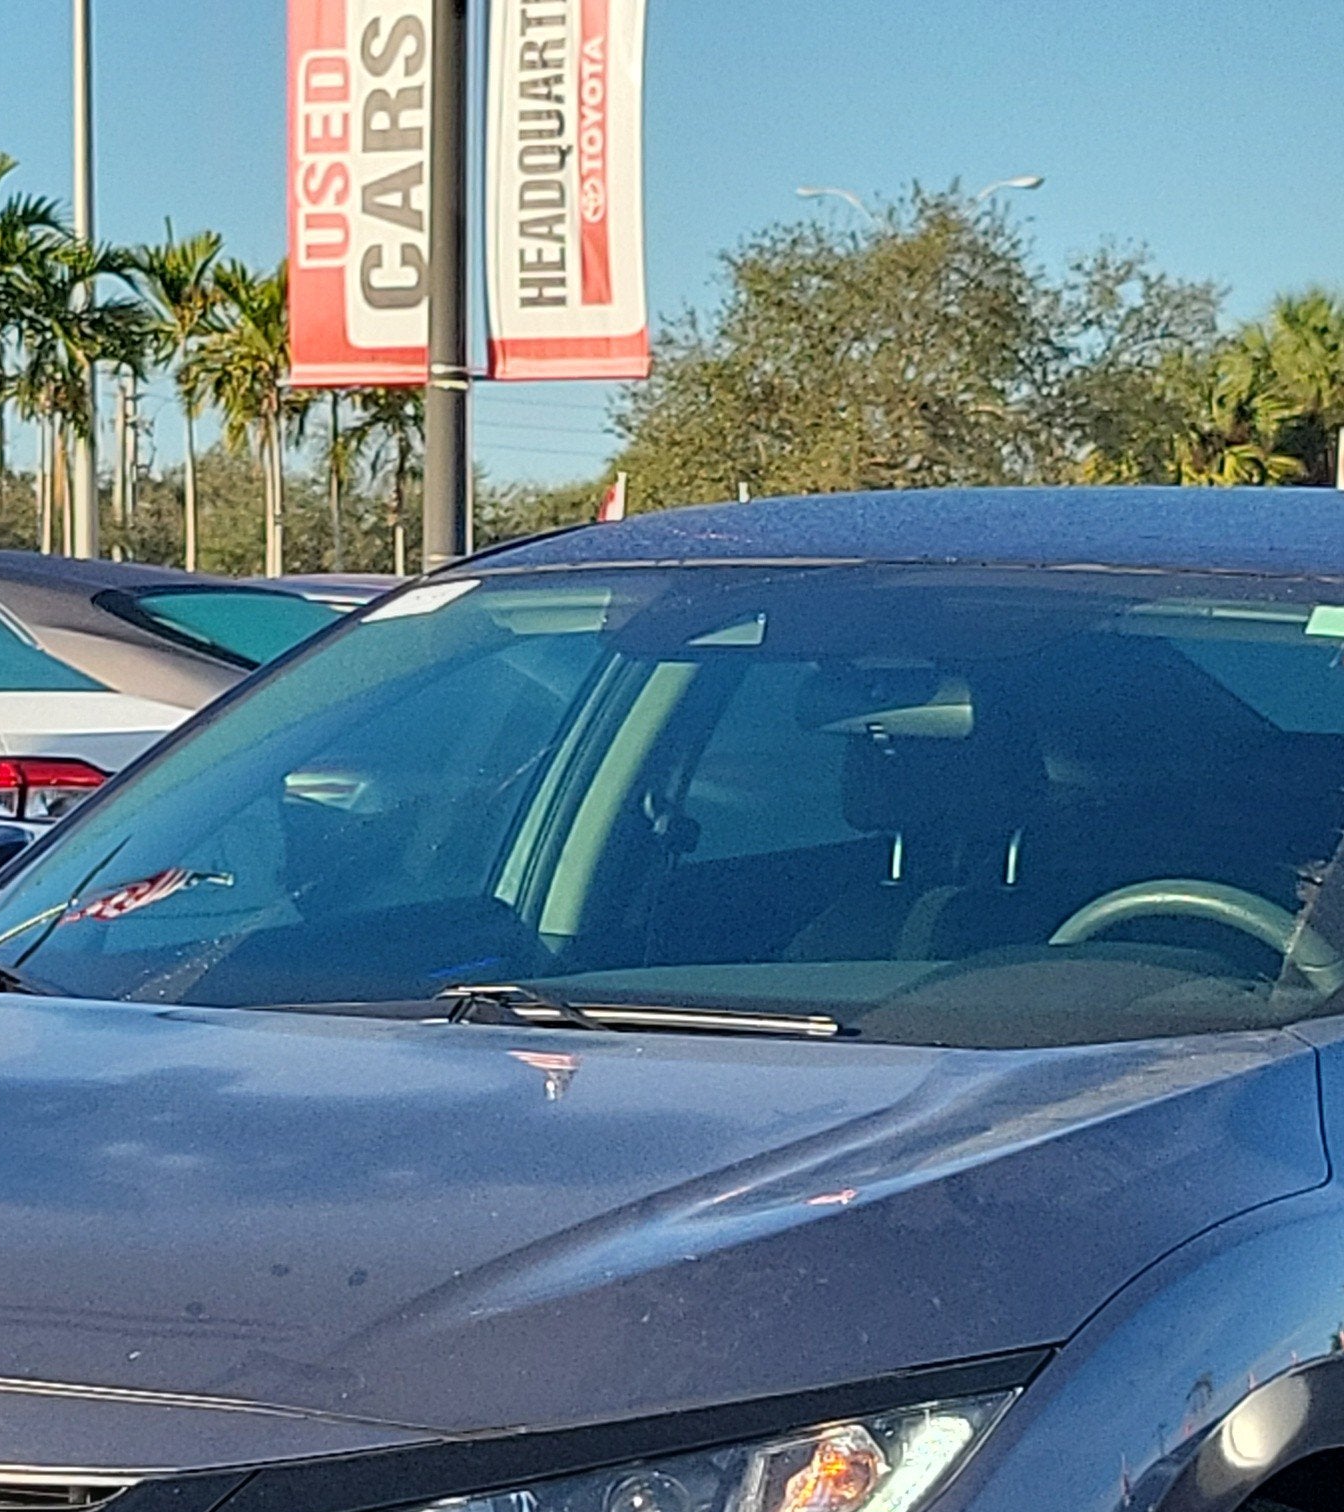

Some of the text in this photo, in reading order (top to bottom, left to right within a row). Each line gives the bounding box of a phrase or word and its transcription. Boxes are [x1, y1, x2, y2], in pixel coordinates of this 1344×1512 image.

[303, 56, 349, 261] USED
[360, 14, 427, 310] CARS
[518, 0, 572, 308] HEADQUART
[581, 36, 605, 176] TOYOTA
